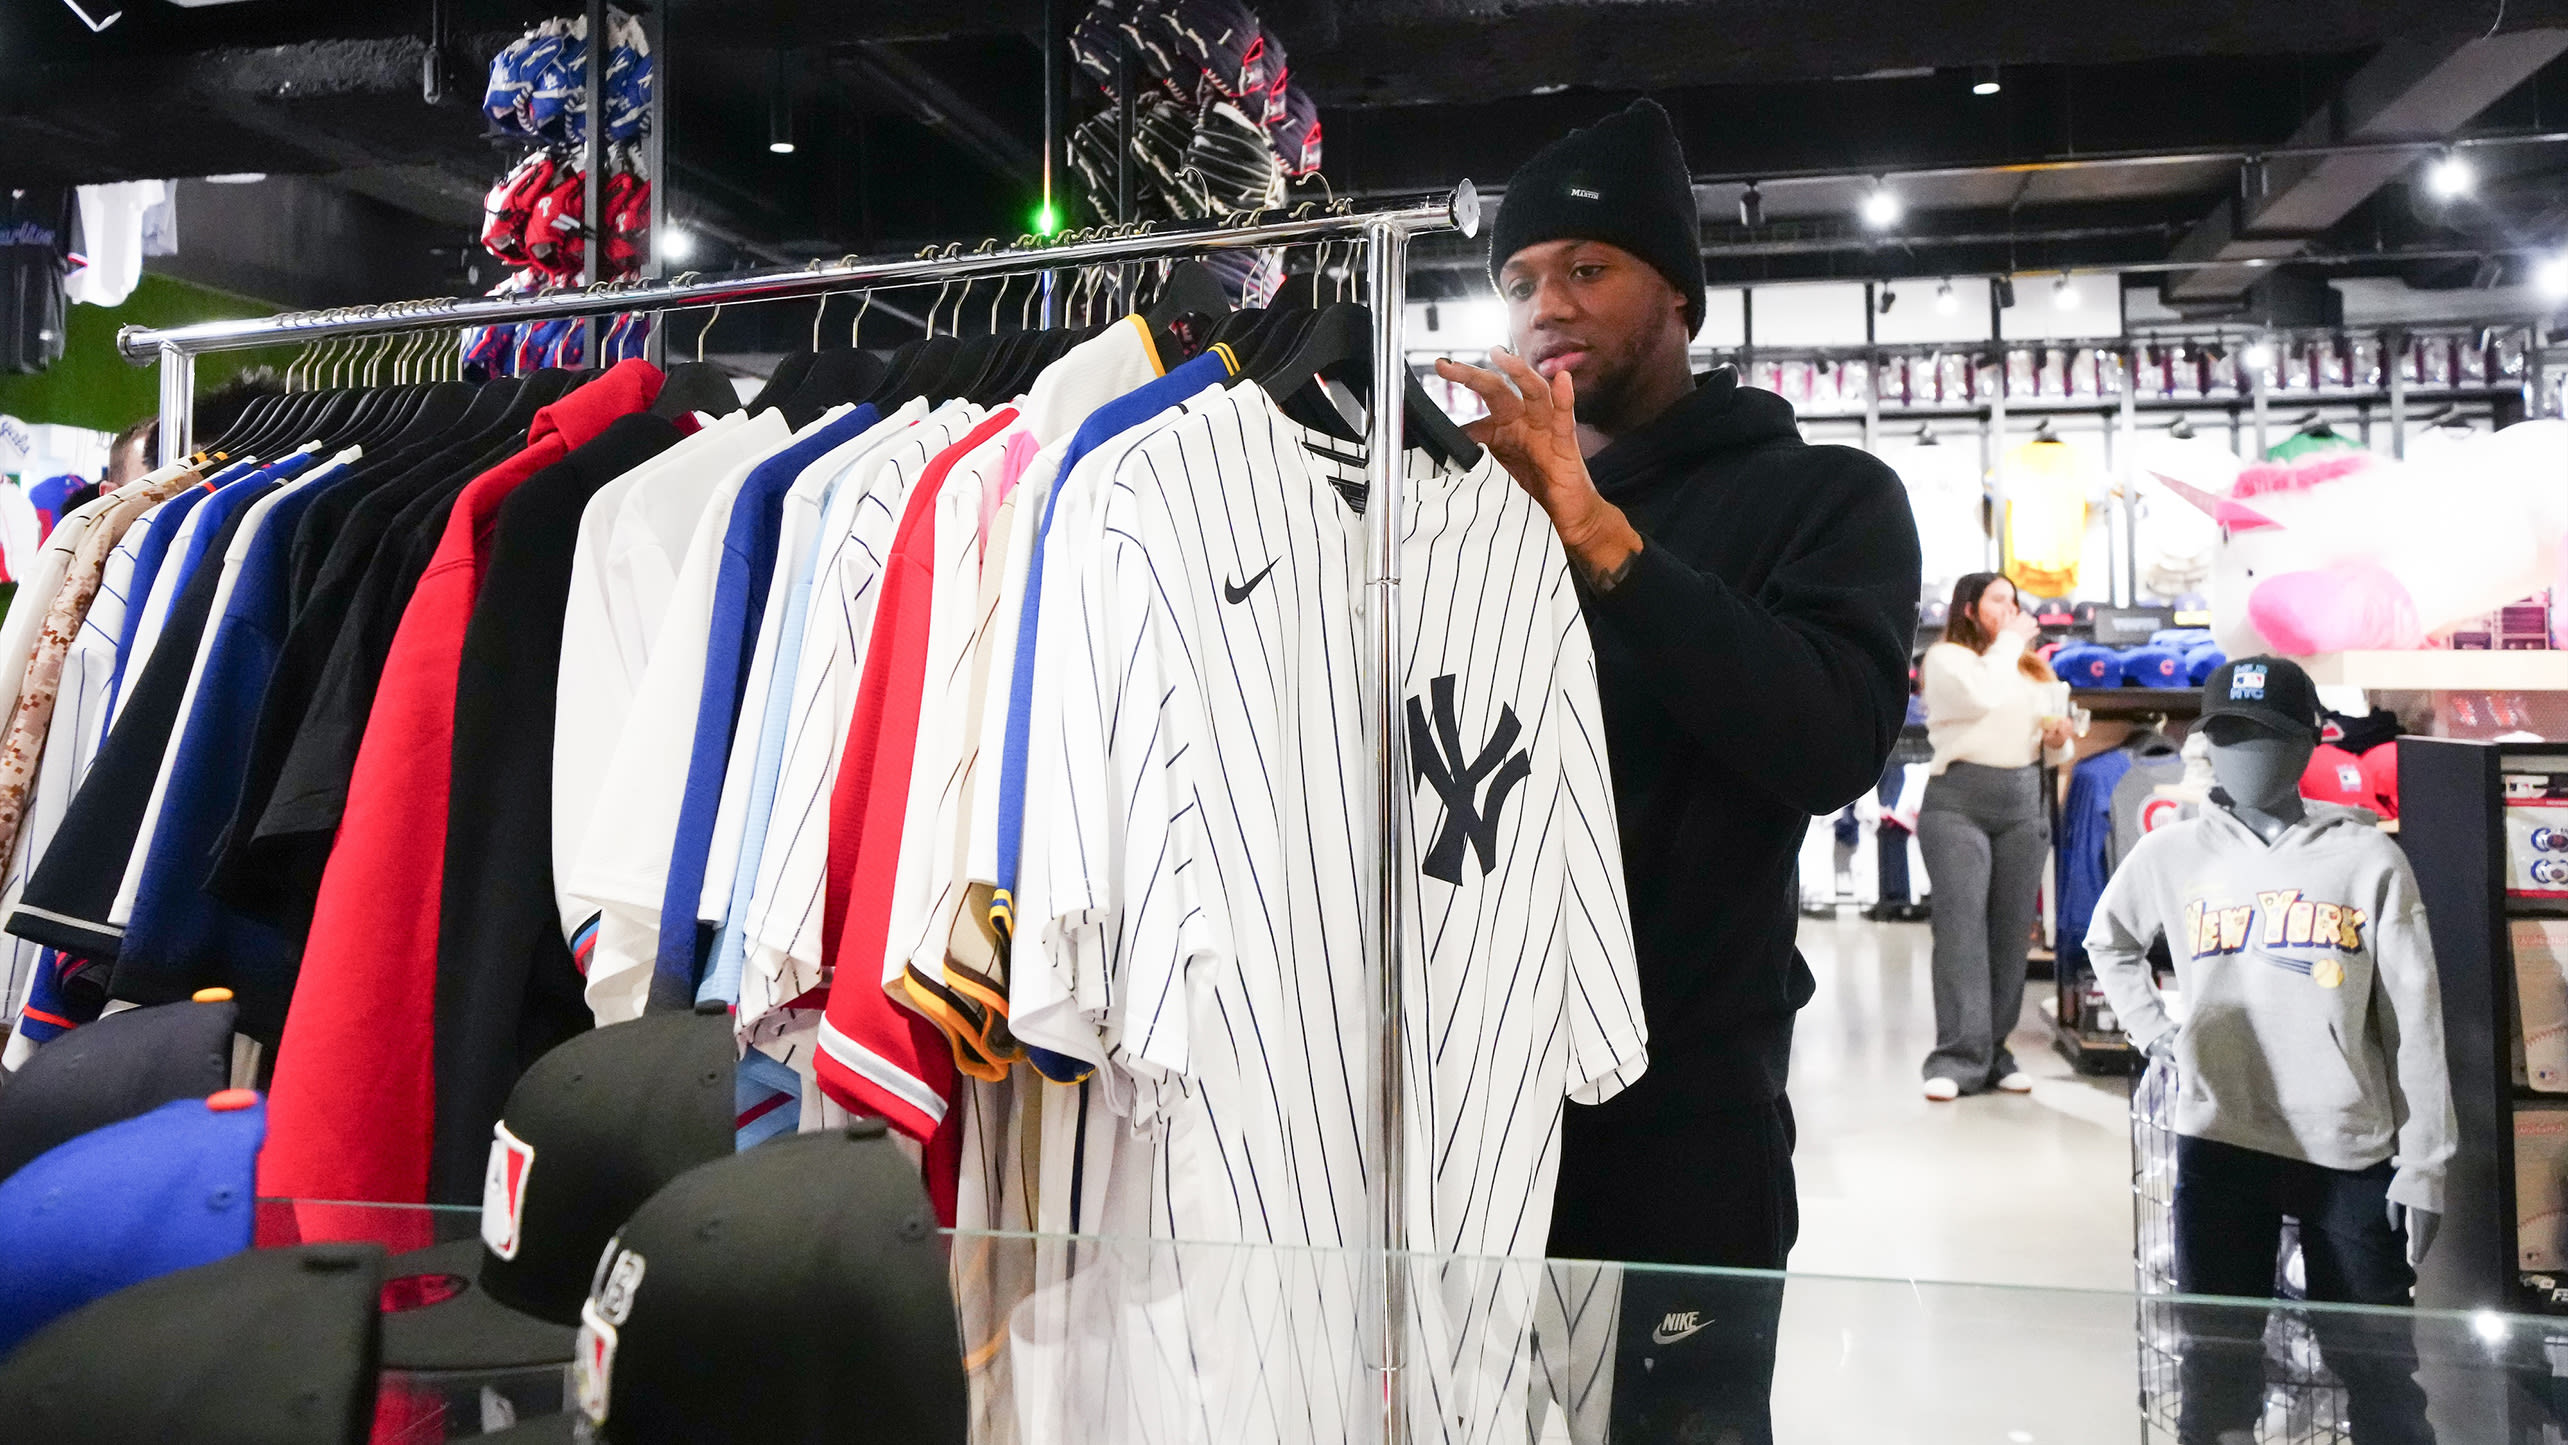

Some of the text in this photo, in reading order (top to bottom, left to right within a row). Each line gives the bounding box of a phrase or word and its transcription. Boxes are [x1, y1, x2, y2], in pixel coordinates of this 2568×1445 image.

[2229, 687, 2265, 700] NYC
[2256, 889, 2368, 954] YORK
[1662, 1311, 1700, 1331] NIKE
